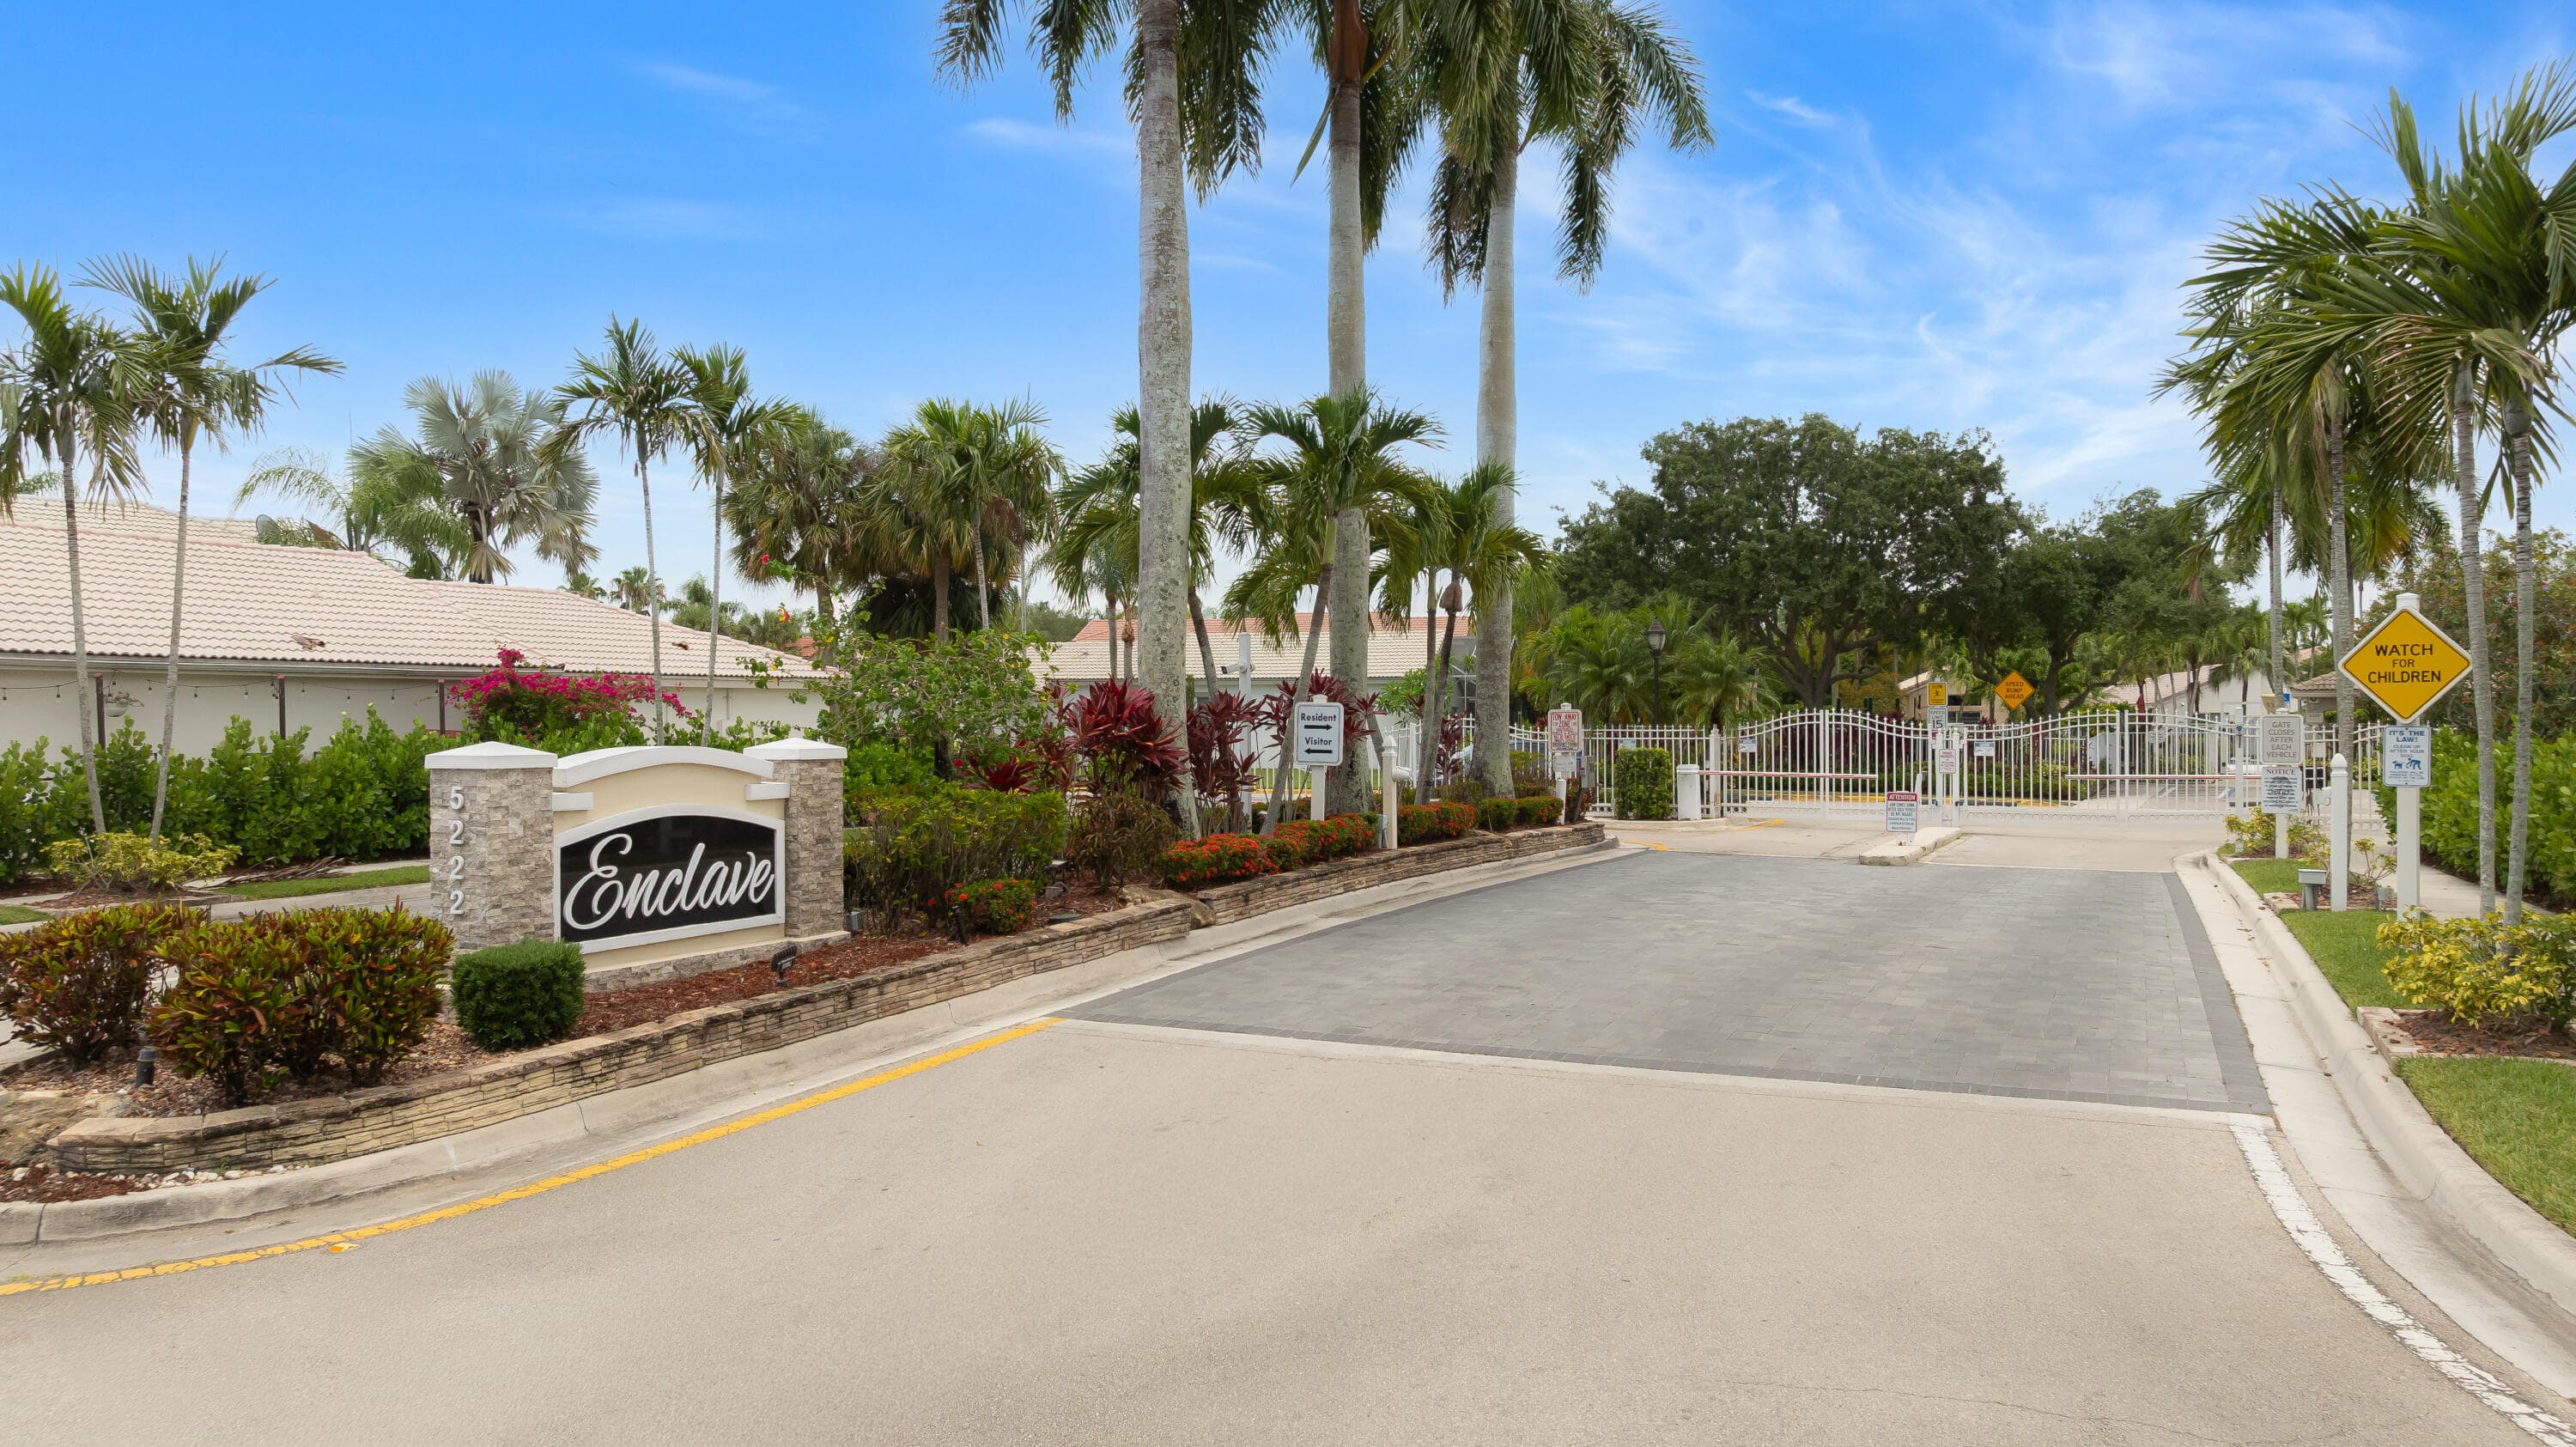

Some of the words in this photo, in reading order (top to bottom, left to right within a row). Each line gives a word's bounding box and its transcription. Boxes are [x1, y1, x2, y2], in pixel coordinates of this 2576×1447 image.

[2374, 643, 2433, 656] WATCH
[2391, 659, 2415, 668] FOR
[2367, 670, 2441, 684] CHILDREN
[1300, 713, 1336, 721] Resident
[1932, 720, 1943, 729] 15
[1304, 737, 1333, 745] Visitor
[562, 833, 775, 930] Enclave
